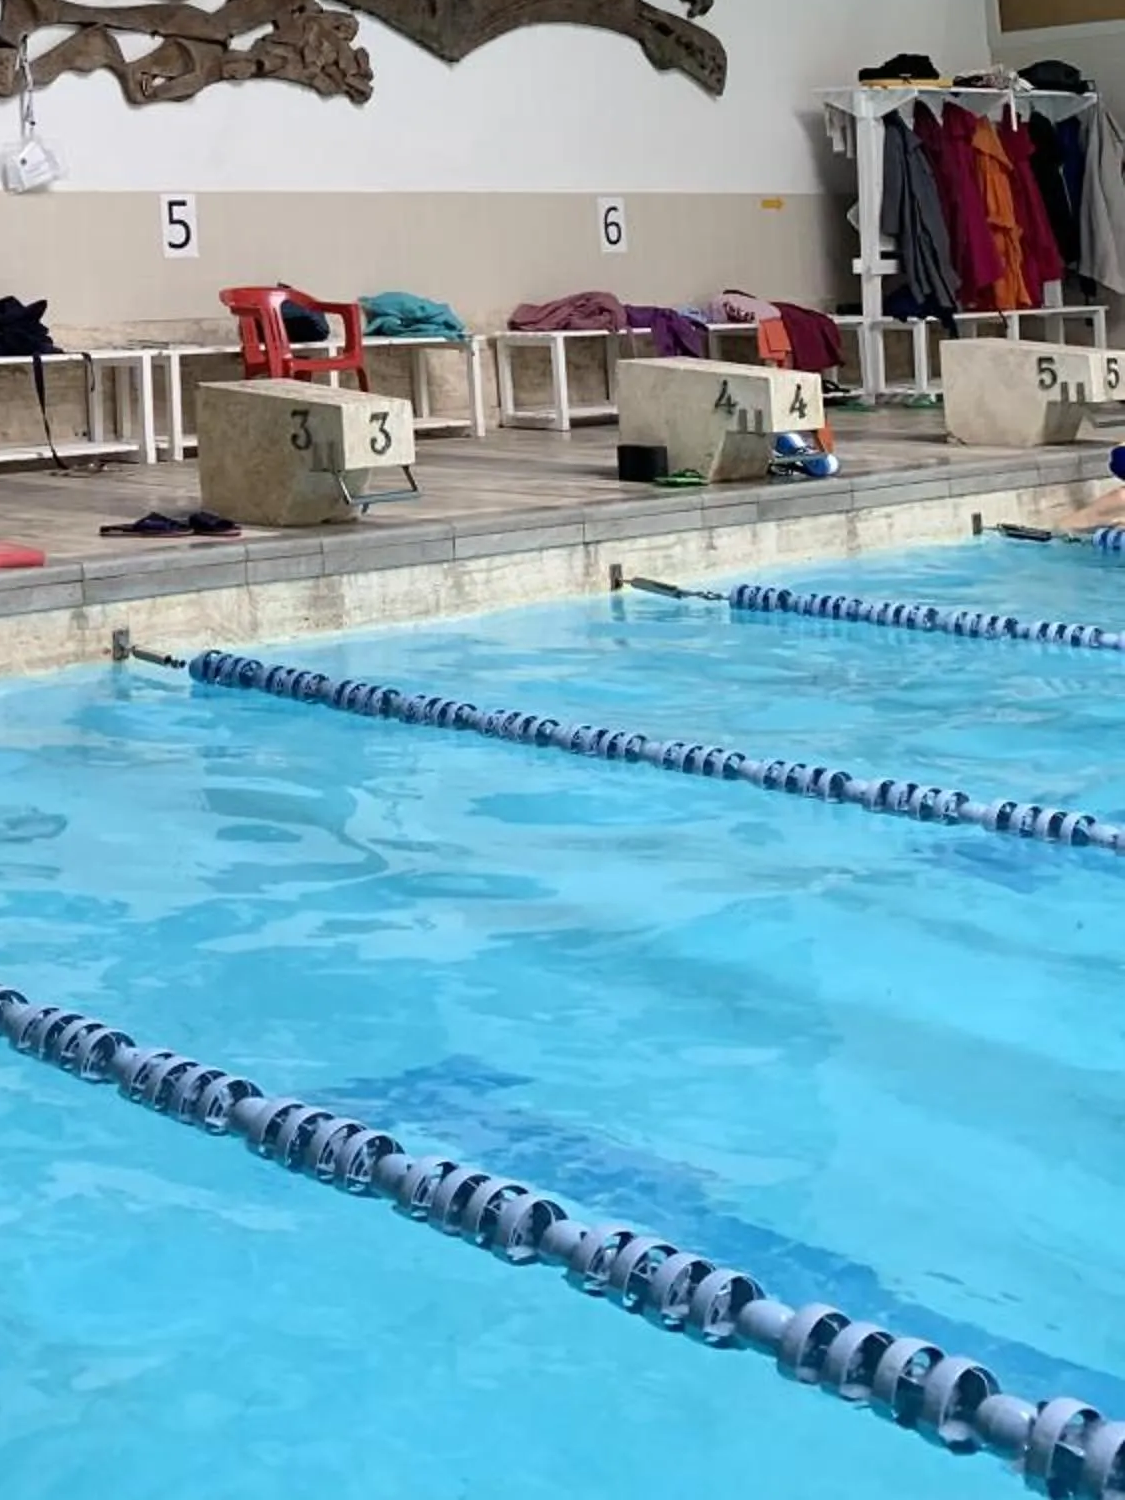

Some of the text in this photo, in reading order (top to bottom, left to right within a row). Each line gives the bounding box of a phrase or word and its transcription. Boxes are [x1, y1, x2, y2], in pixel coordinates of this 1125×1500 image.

[167, 200, 191, 249] 5
[604, 206, 622, 245] 6
[1037, 356, 1058, 390] 5
[1106, 357, 1120, 389] 5
[714, 379, 737, 416] 4
[790, 383, 808, 419] 4
[291, 408, 313, 451] 3
[369, 411, 392, 455] 3
